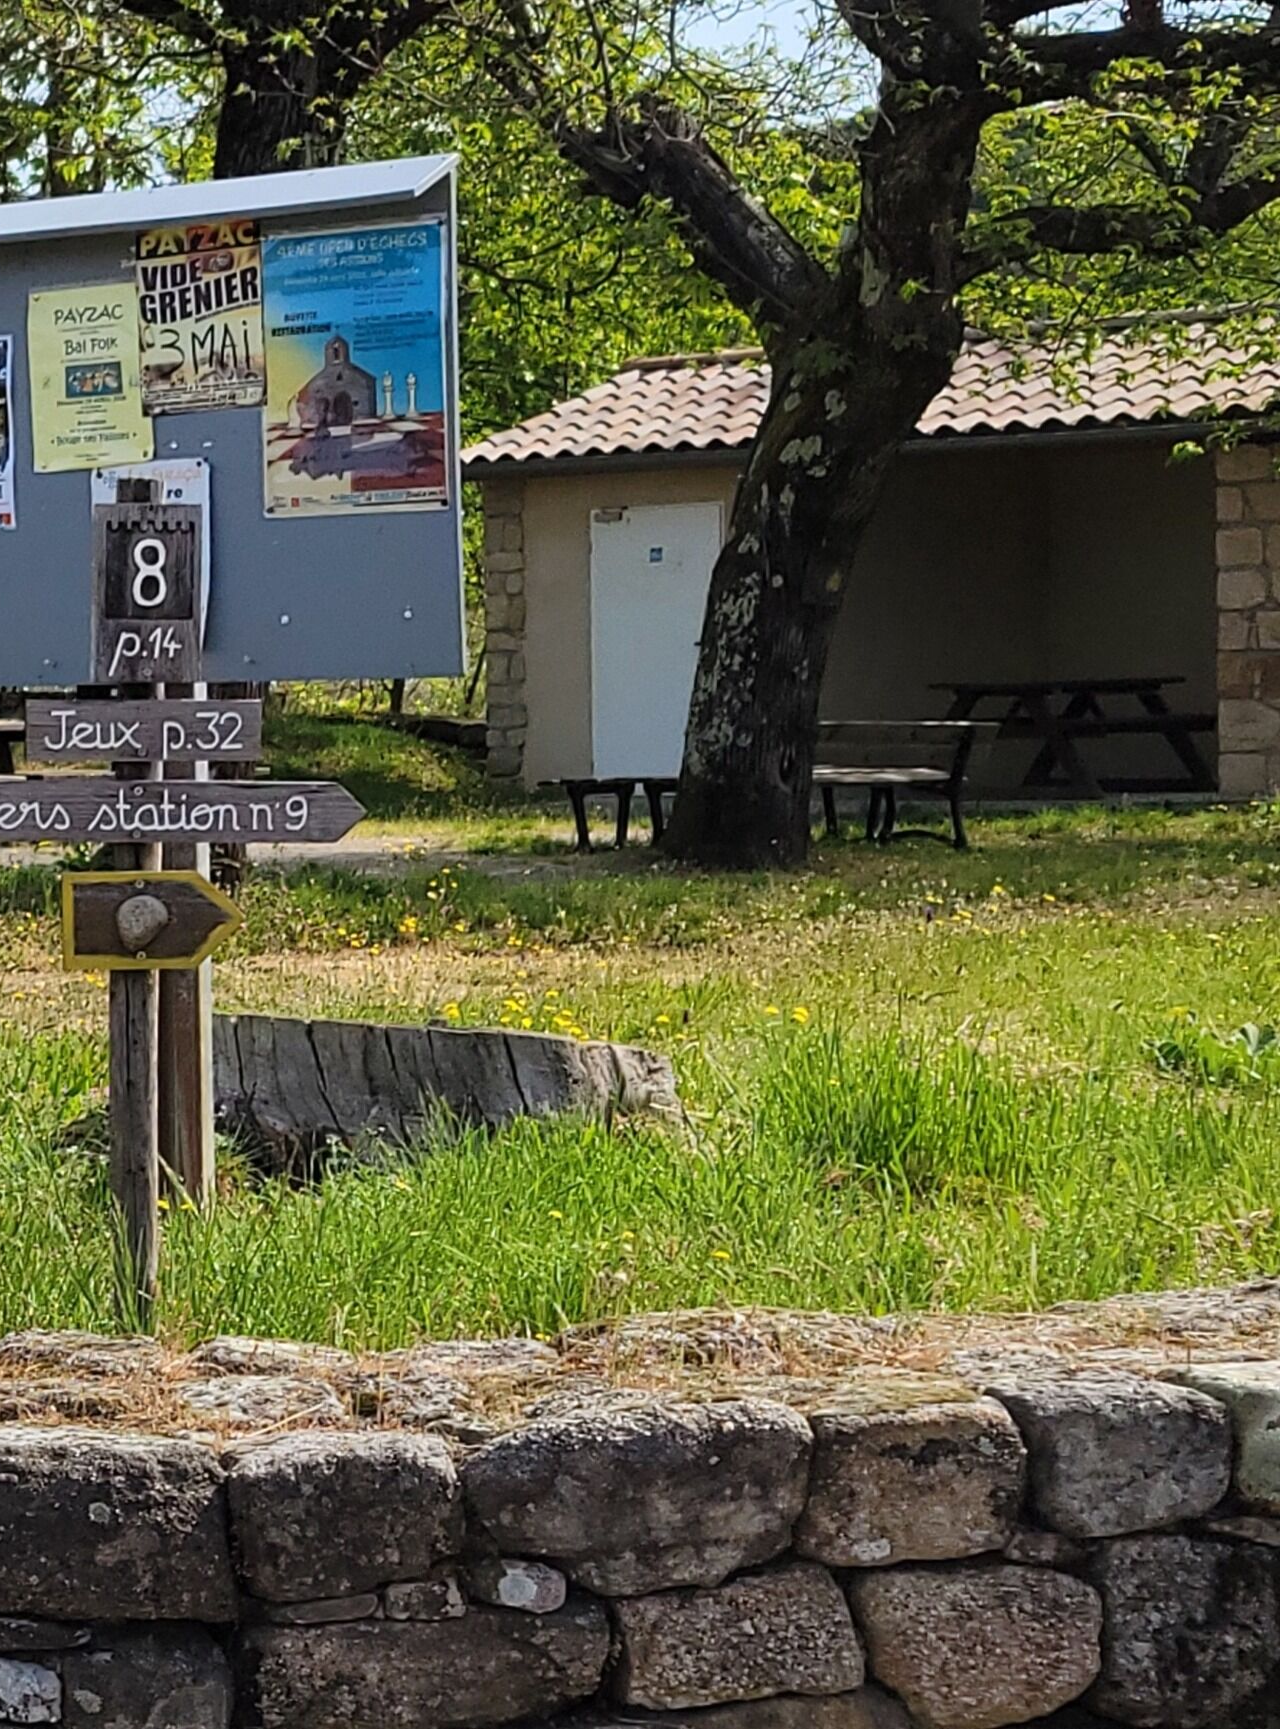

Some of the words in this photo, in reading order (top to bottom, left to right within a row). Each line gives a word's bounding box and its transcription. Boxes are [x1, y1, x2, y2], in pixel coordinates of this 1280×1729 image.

[140, 222, 254, 257] PAYZAC
[139, 266, 259, 325] GRENIER
[141, 258, 203, 292] VIDE
[53, 304, 124, 326] PAYZAC
[64, 339, 86, 356] Bal
[159, 328, 185, 378] 3
[132, 538, 167, 607] 8
[108, 627, 182, 677] p.14
[44, 709, 142, 751] Jeux
[162, 711, 243, 760] p.32
[88, 788, 241, 832] station
